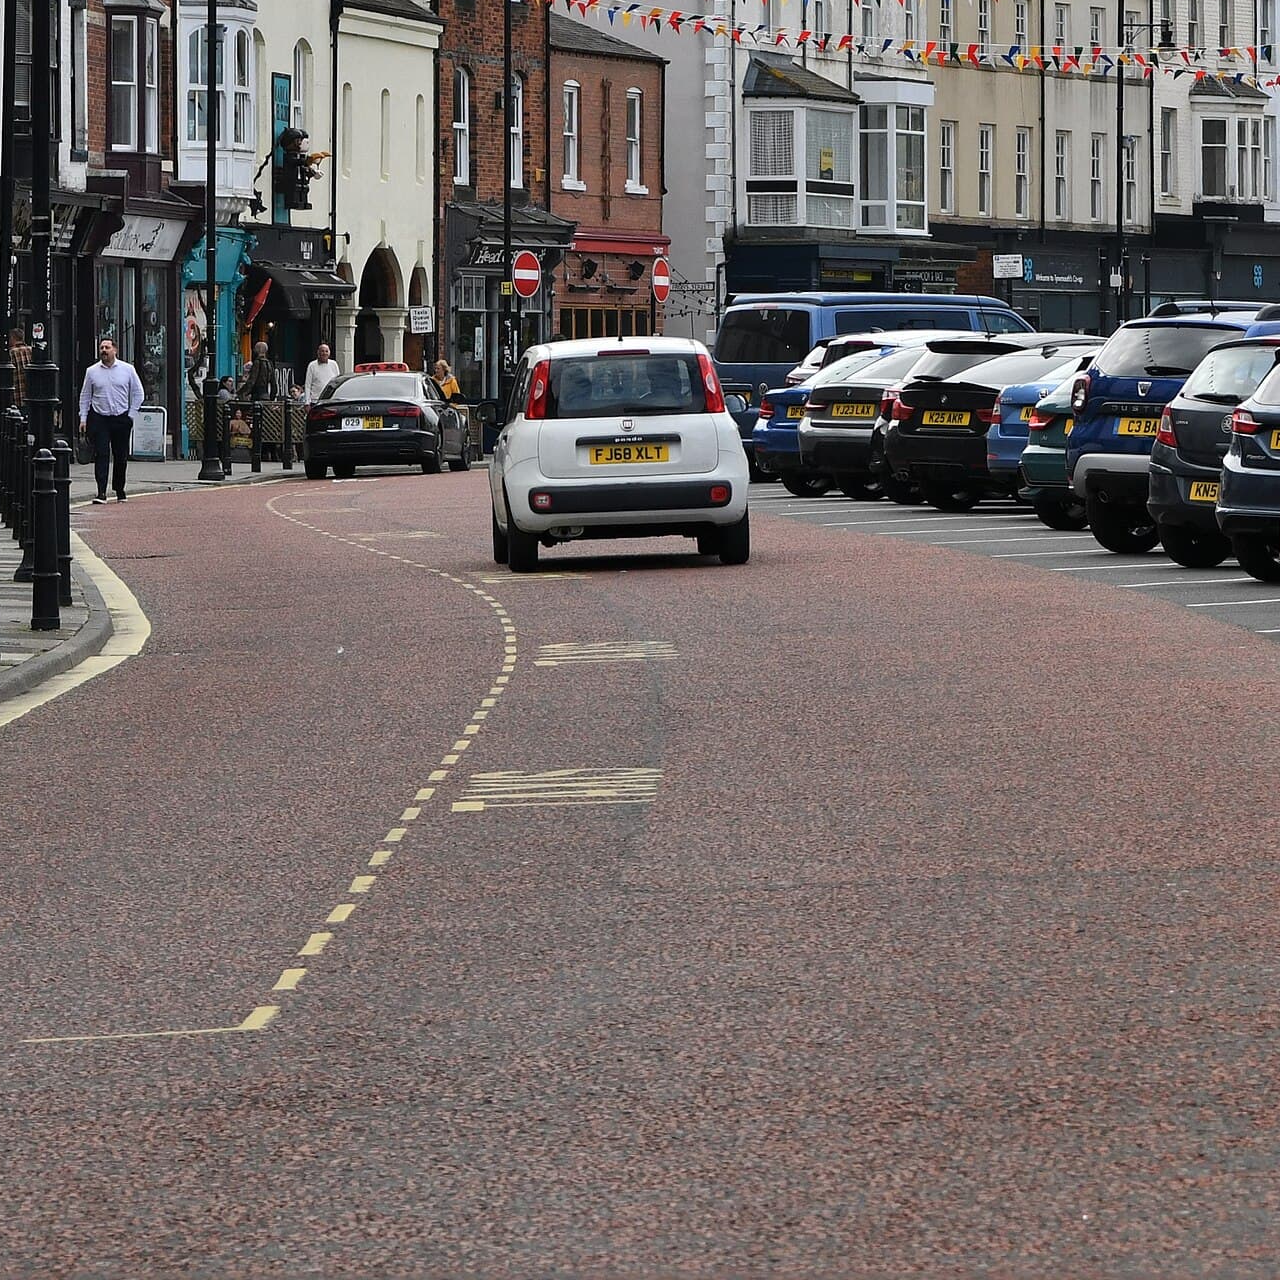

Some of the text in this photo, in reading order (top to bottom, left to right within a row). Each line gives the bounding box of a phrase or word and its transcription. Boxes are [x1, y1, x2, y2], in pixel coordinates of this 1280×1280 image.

[835, 405, 871, 415] YJ23 LAX
[345, 418, 360, 426] 029
[928, 412, 964, 424] K25 AKR
[1127, 421, 1157, 433] C3 BA
[595, 447, 663, 462] FJ68 XLT
